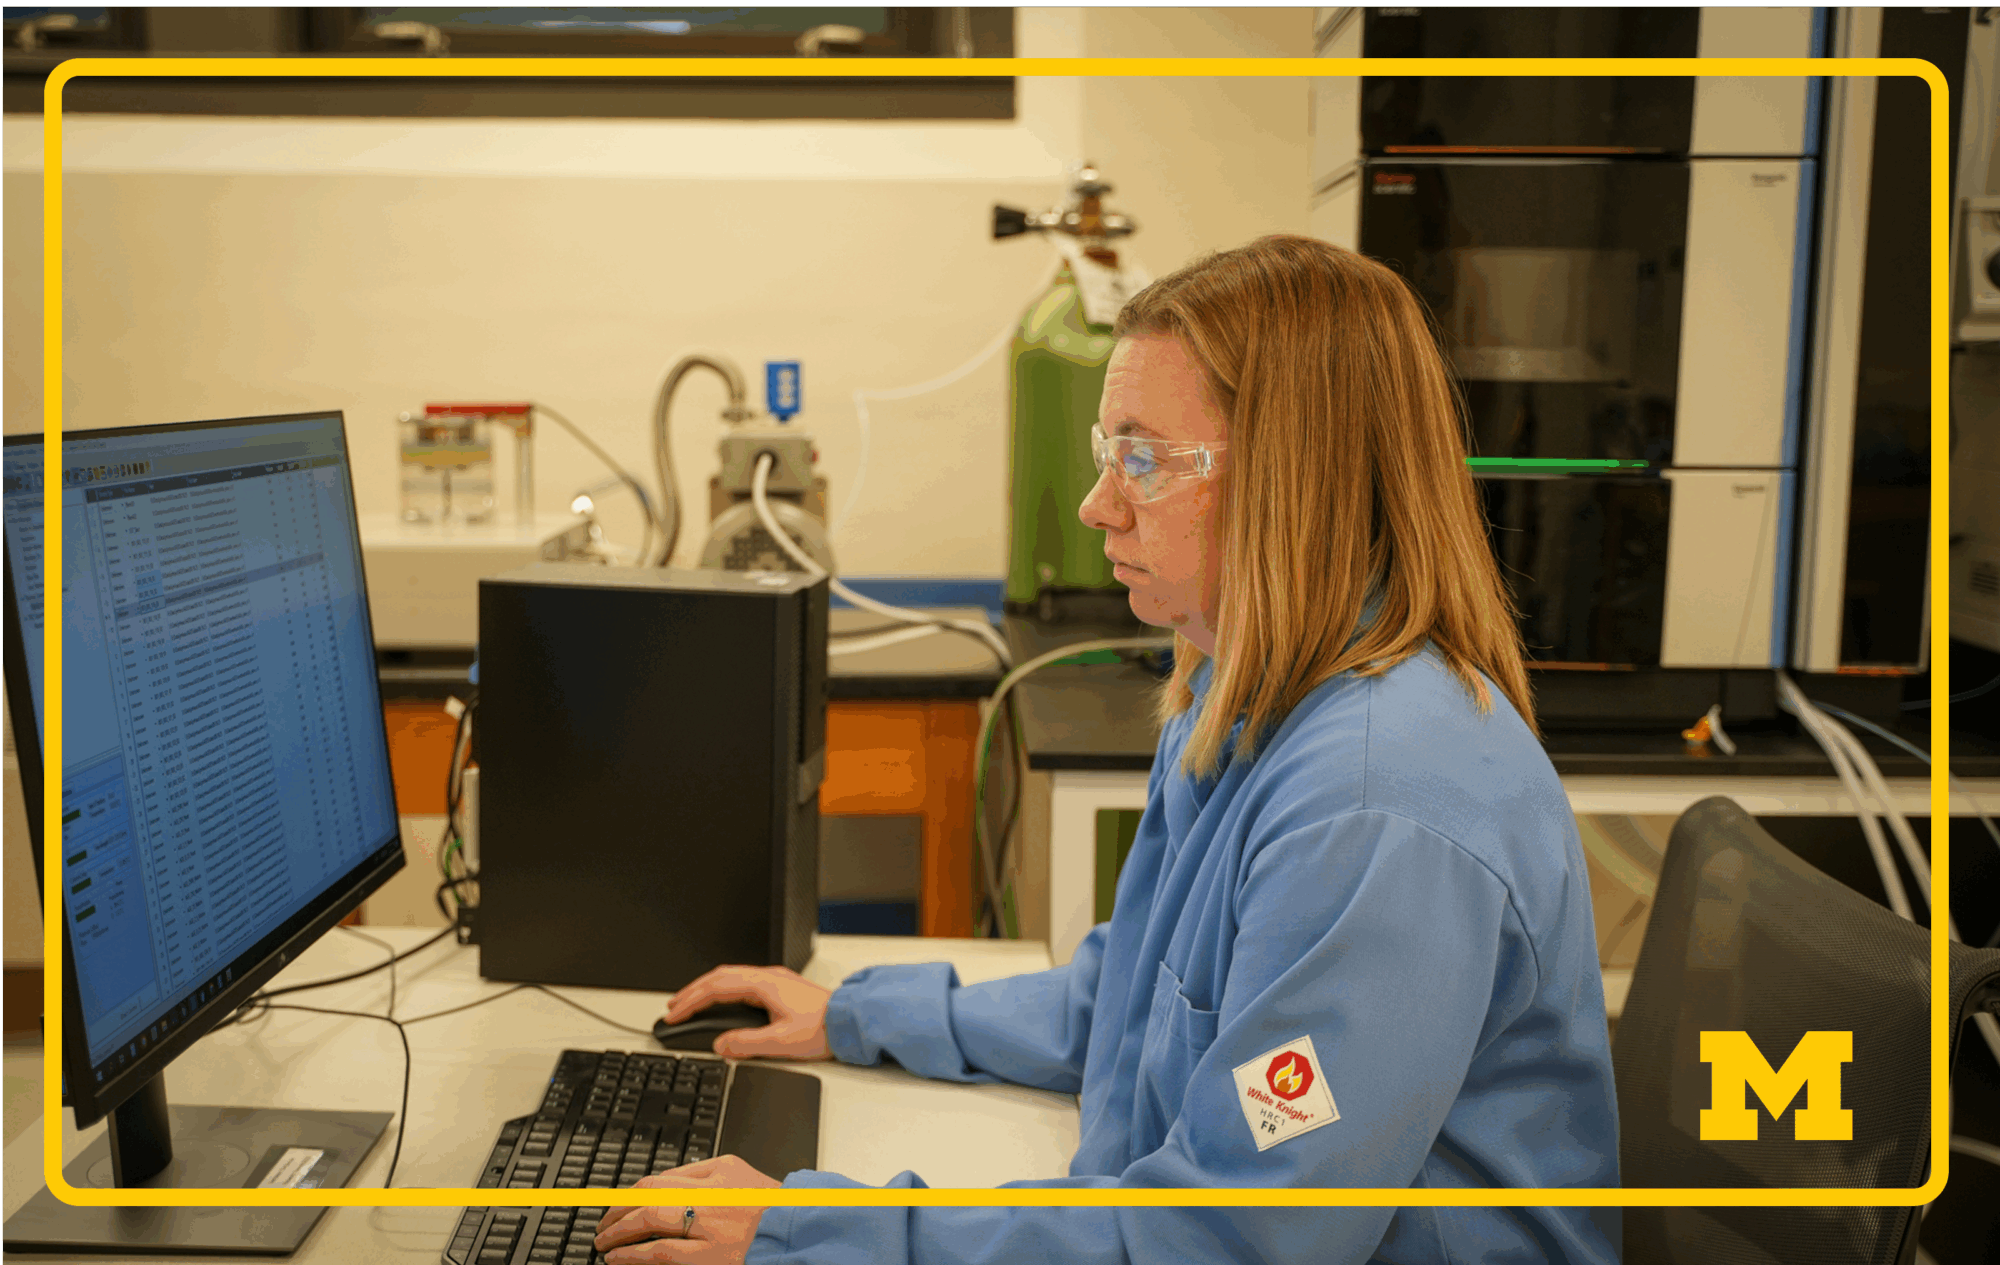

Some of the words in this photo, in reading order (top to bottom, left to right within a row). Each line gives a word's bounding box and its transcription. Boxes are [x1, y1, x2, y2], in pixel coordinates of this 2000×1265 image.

[1247, 1086, 1274, 1106] White
[1260, 1108, 1281, 1123] HRC
[1260, 1120, 1277, 1135] FR
